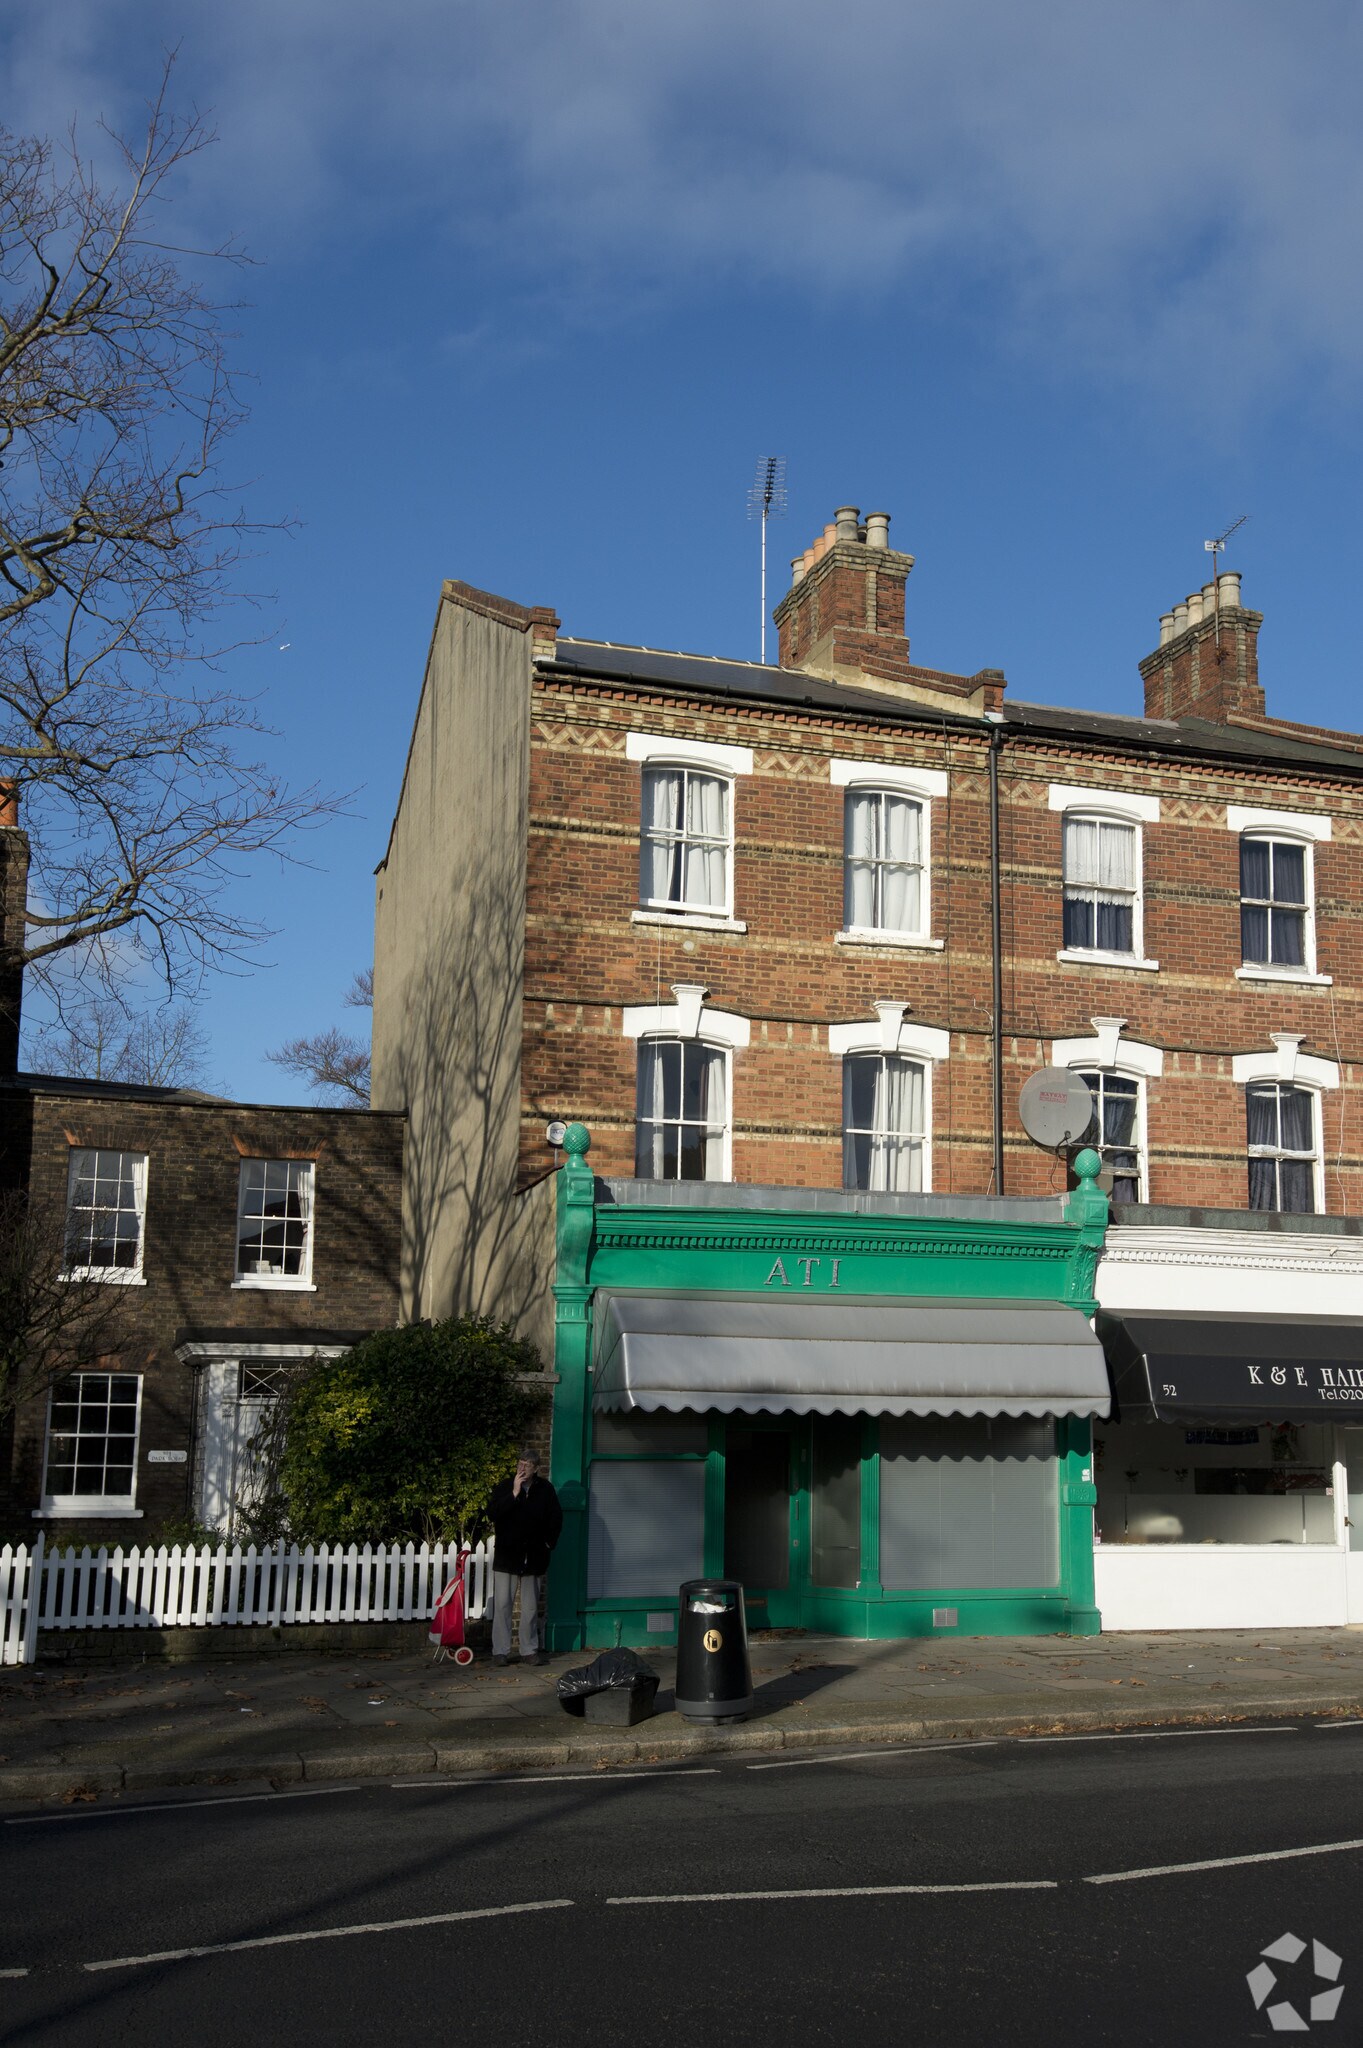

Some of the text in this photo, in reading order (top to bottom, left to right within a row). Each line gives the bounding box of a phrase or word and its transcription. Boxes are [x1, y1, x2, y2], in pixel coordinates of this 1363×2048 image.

[763, 1256, 842, 1288] ATI
[1247, 1365, 1264, 1385] K
[1270, 1366, 1287, 1386] &
[1294, 1366, 1308, 1387] E
[1162, 1384, 1177, 1397] 52
